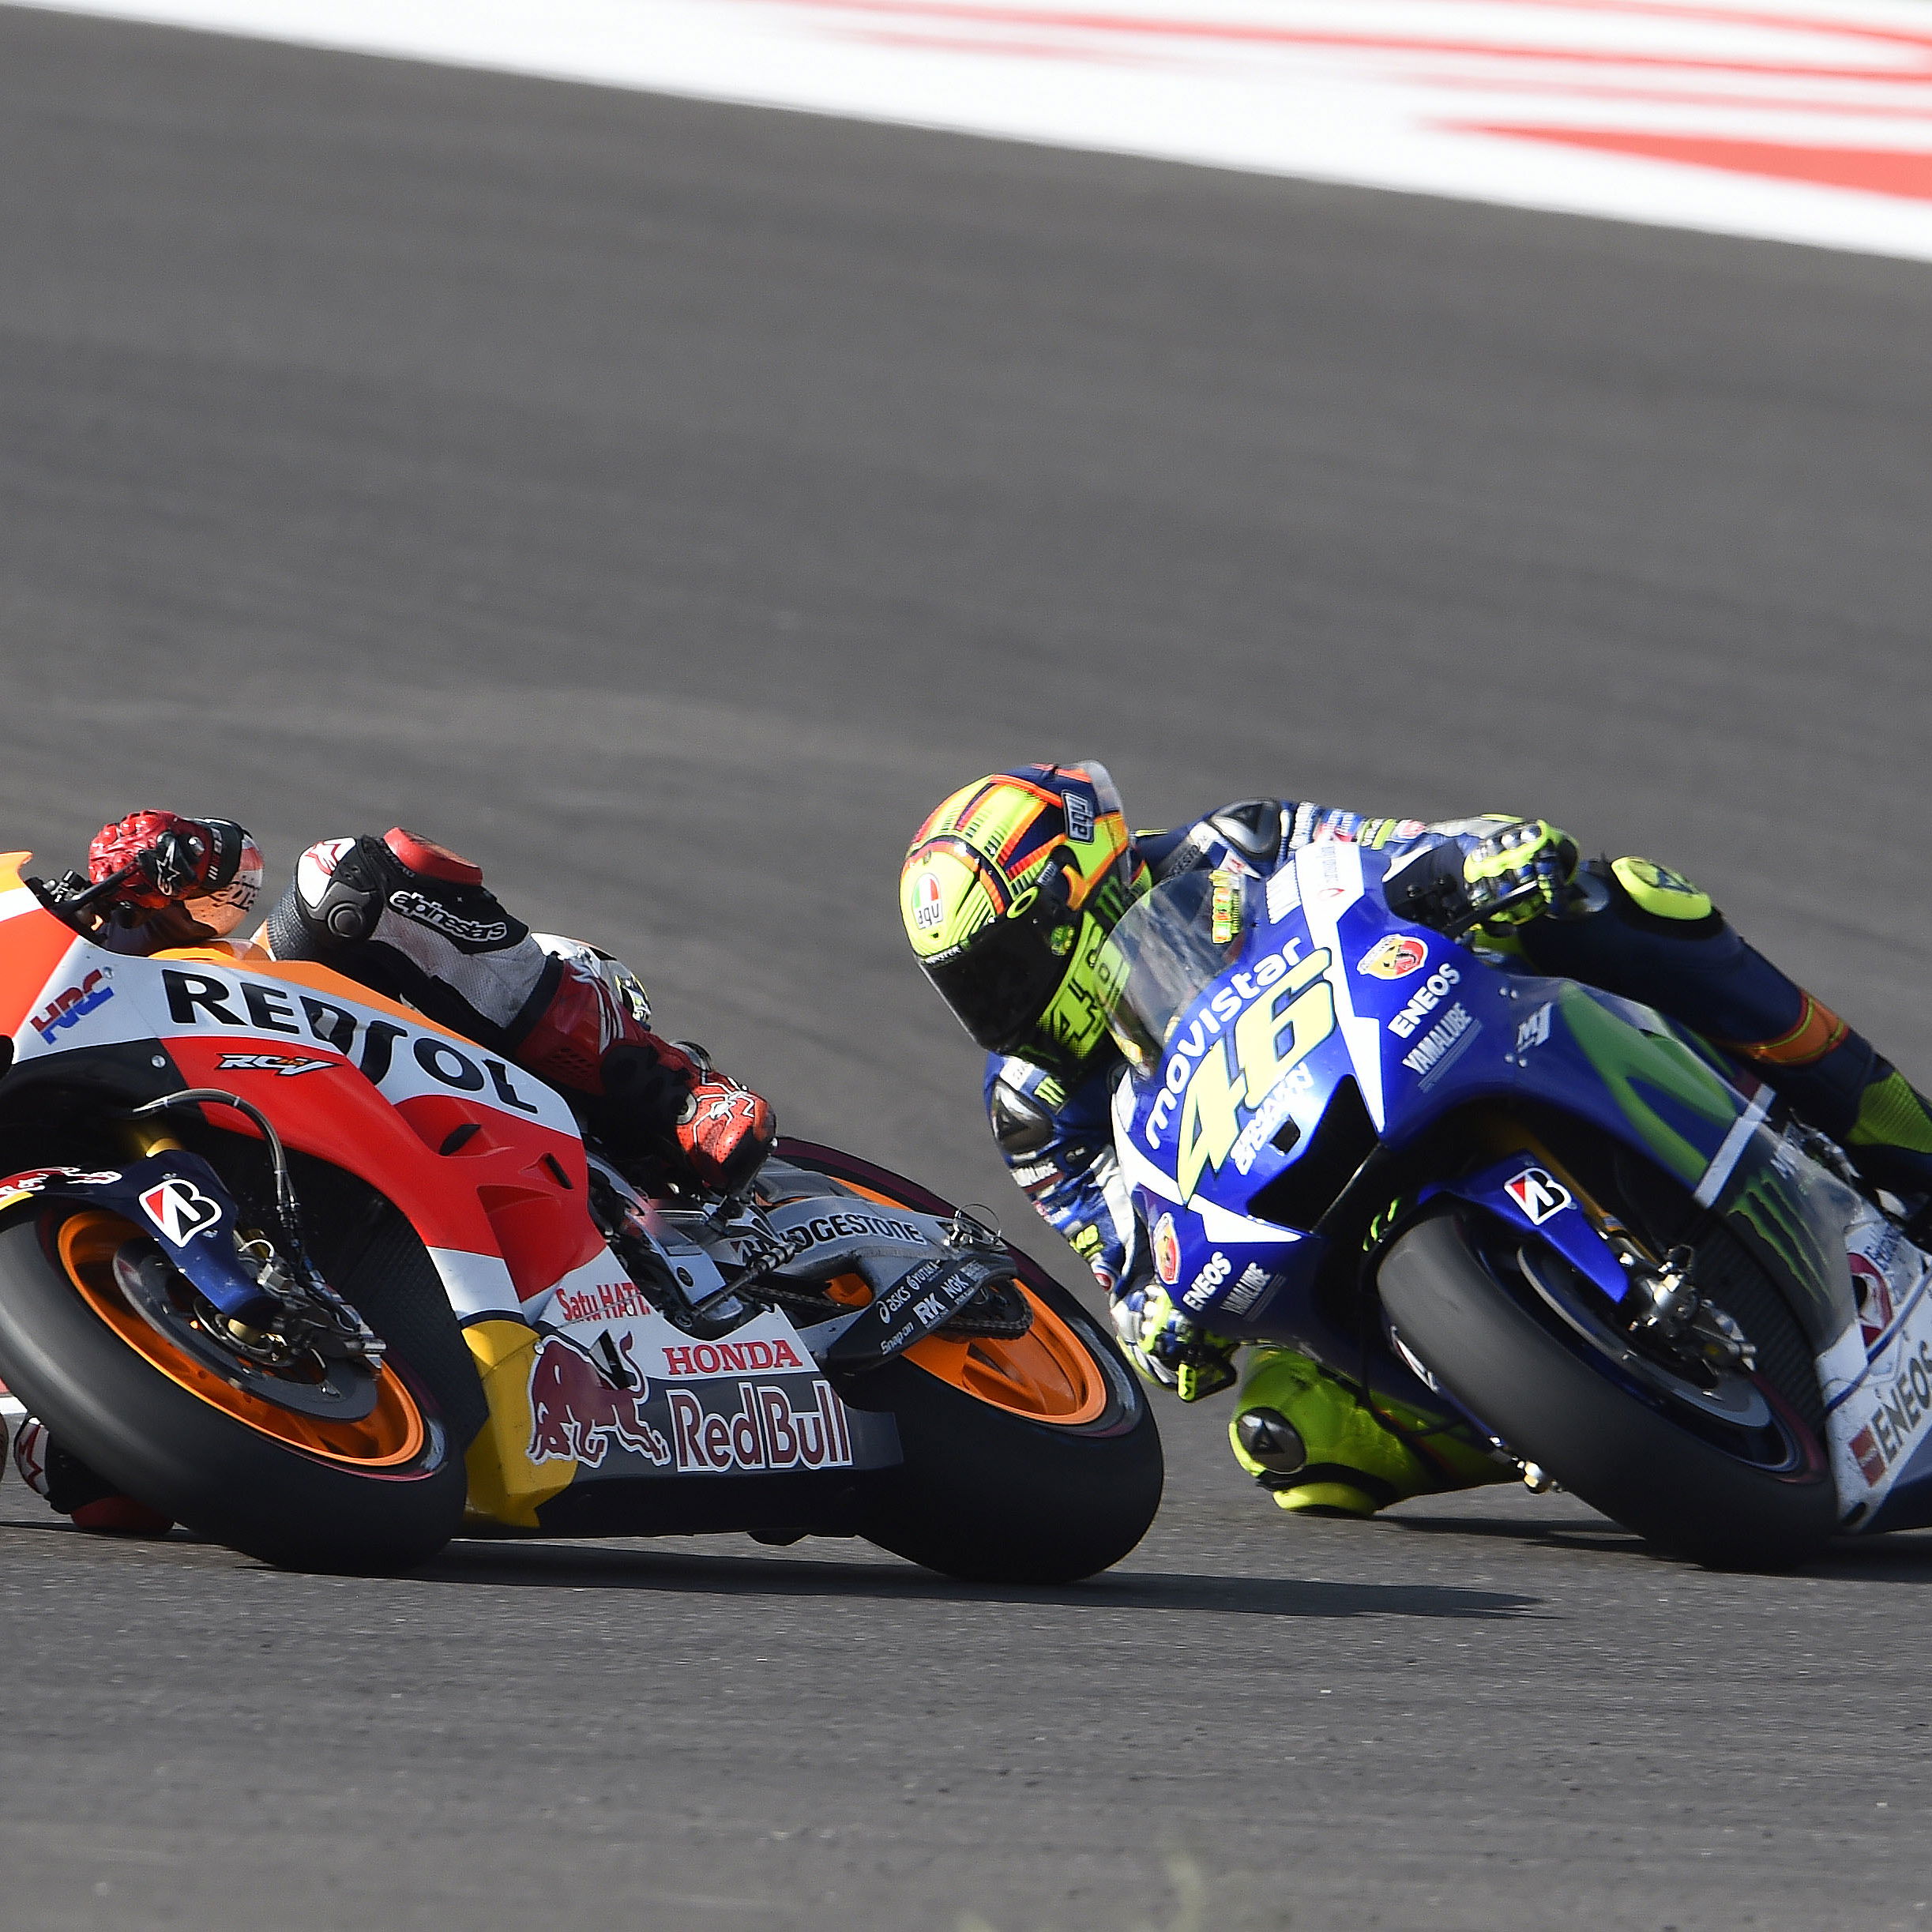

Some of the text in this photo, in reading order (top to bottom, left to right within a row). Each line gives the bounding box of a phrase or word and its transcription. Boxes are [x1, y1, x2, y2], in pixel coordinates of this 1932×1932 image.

[1387, 962, 1460, 1039] ENEOS
[1145, 937, 1302, 1150] movistar
[1402, 1002, 1473, 1076] YAMALUBE
[1178, 947, 1332, 1207] 46
[886, 1286, 911, 1312] asics
[912, 1292, 946, 1325] RK
[940, 1273, 970, 1299] NGK
[1182, 1251, 1232, 1313] ENEOS
[662, 1339, 803, 1376] HONDA
[666, 1380, 853, 1472] Red Bull
